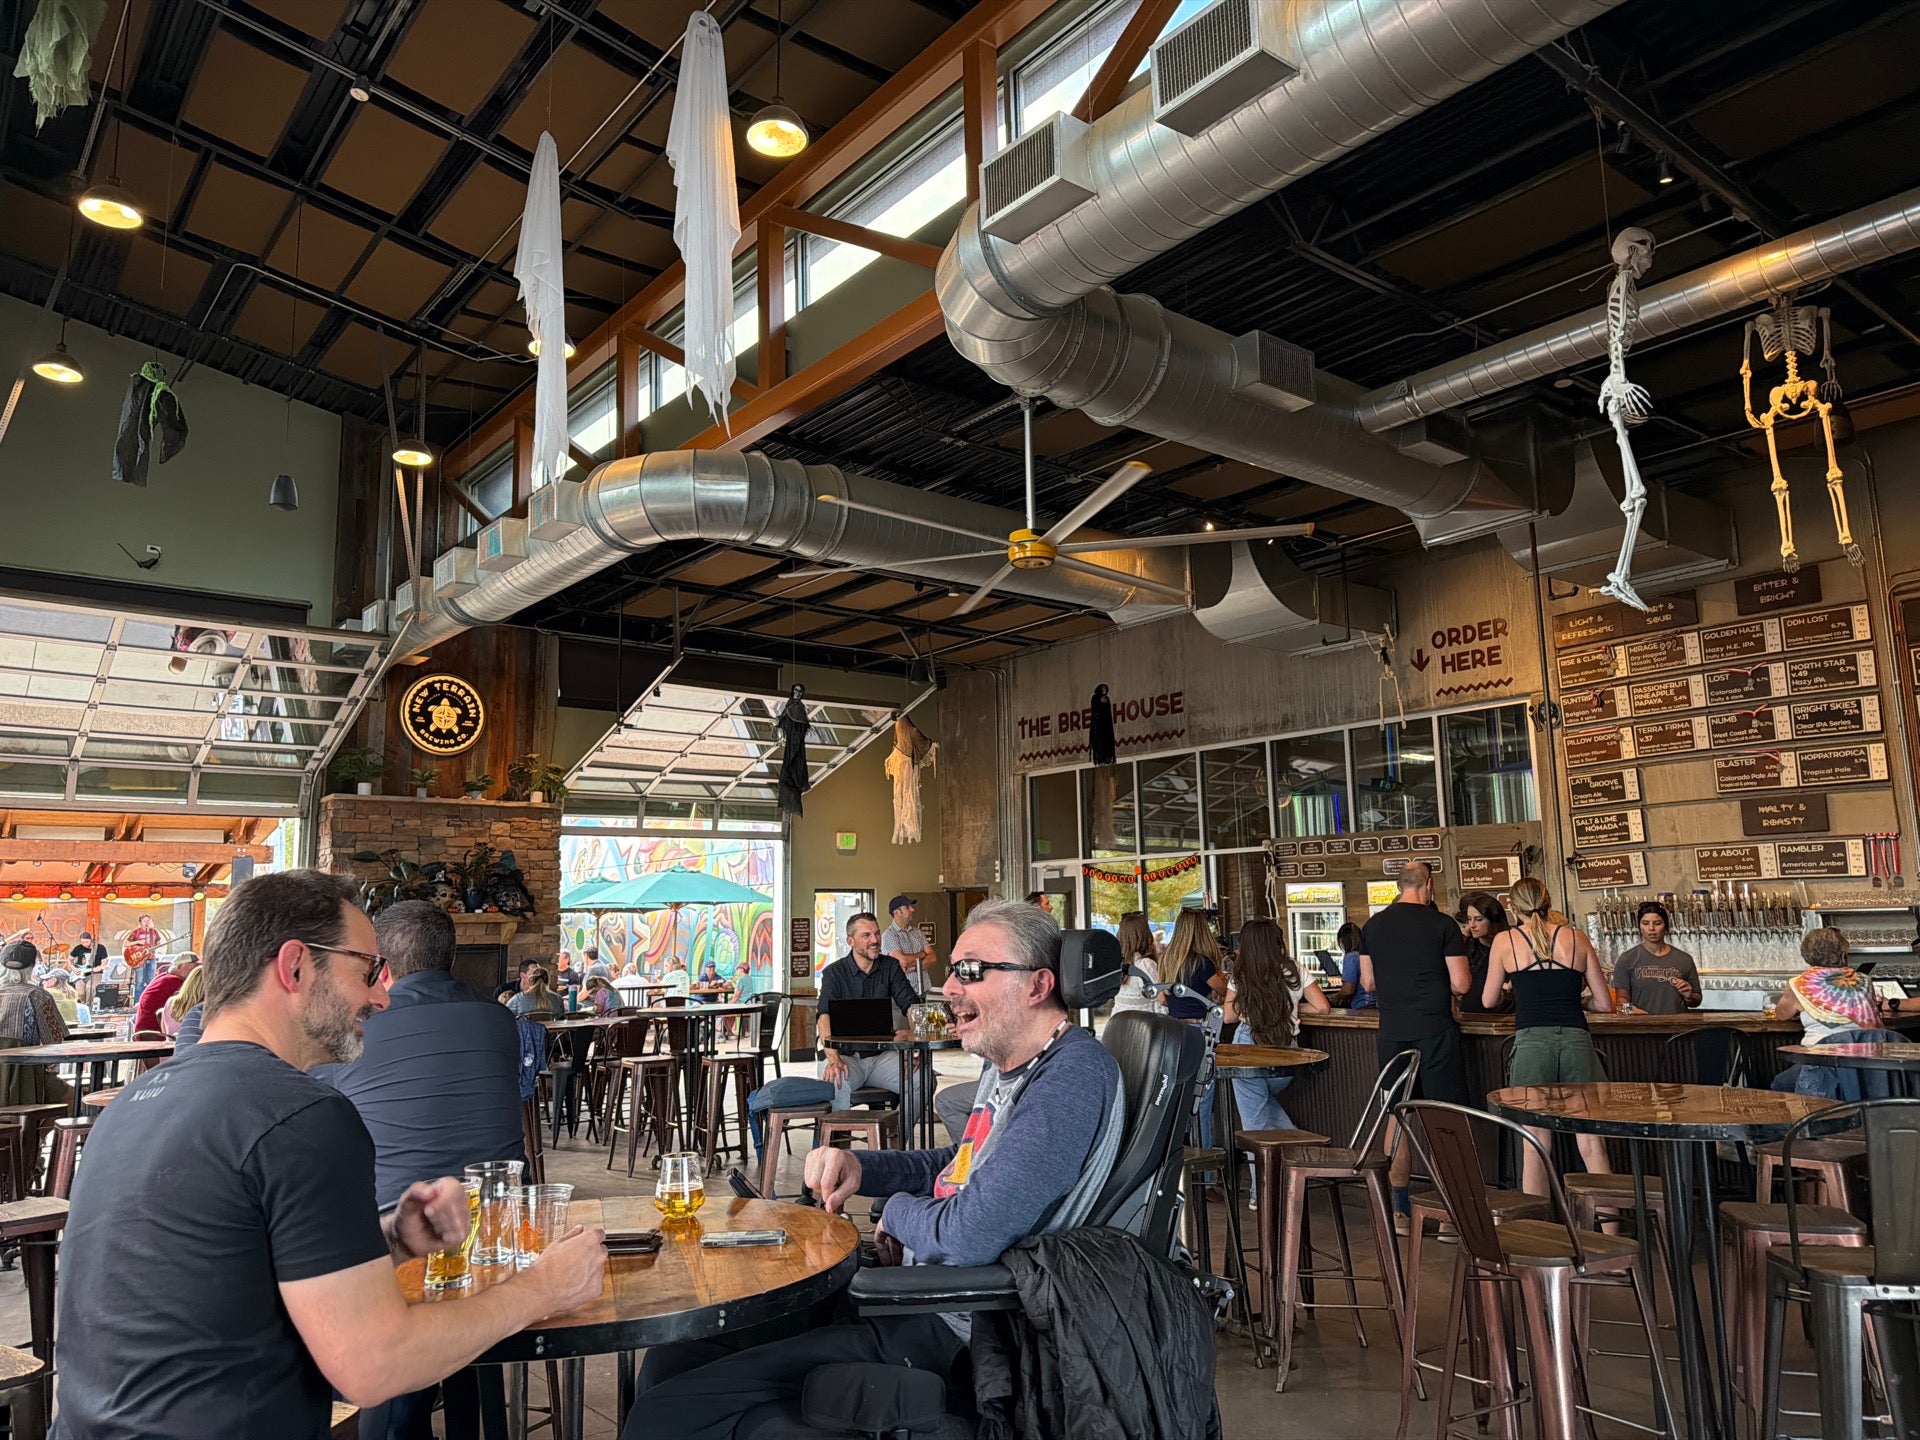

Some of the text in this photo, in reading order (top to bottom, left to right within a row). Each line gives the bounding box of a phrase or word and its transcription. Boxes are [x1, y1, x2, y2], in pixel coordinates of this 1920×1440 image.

[1753, 577, 1800, 592] BITTER &
[1759, 590, 1796, 604] BRIGHT
[1668, 602, 1675, 610] &
[1569, 615, 1594, 628] LIGHT
[1646, 614, 1672, 625] SOUR
[1786, 614, 1829, 627] DDH LOST
[1431, 618, 1509, 650] ORDER
[1561, 624, 1615, 641] REFRESHING
[1704, 625, 1761, 640] GOLDEN HAZE
[1629, 642, 1659, 654] MIRAGE
[1441, 645, 1502, 674] HERE
[1560, 659, 1576, 667] RISE
[1583, 653, 1605, 663] CLIMB
[1630, 650, 1667, 661] Dry-Hopped
[1631, 658, 1652, 667] Mosaic
[1791, 659, 1846, 671] NORTH STAR
[1708, 673, 1731, 683] LOST
[1791, 670, 1808, 678] v.49
[1633, 680, 1687, 694] PASSIONFRUIT
[1792, 678, 1812, 686] Hazy
[1634, 689, 1675, 700] PINEAPPLE
[1710, 688, 1742, 696] Colorado
[412, 687, 429, 713] NEW
[434, 682, 477, 718] TERRAIN
[1562, 694, 1594, 705] SUNTRIP
[1635, 698, 1663, 707] PAPAYA
[1794, 701, 1857, 714] BRIGHT SKIES
[1018, 691, 1184, 740] THE BREHOUSE
[1565, 709, 1590, 718] Belgian
[1711, 716, 1738, 725] NUMB
[1829, 719, 1852, 727] Series
[1638, 721, 1690, 735] TERRA FIRMA
[419, 728, 456, 745] BREWING
[1567, 733, 1616, 746] PILLOW DROPS
[1639, 735, 1653, 743] v.37
[1800, 749, 1867, 761] HOPPATROPICA
[1716, 758, 1757, 769] BLASTER
[1719, 774, 1750, 782] Colorado
[1751, 772, 1766, 780] Pale
[1803, 768, 1833, 777] Tropical
[1571, 777, 1619, 788] LATTE GROOVE
[1758, 803, 1807, 814] MALTY &
[1576, 818, 1593, 826] SALT
[1600, 815, 1618, 823] LIME
[1762, 816, 1805, 827] ROASTY
[1585, 823, 1619, 832] NÓMADA
[1720, 848, 1751, 857] ABOUT
[1780, 844, 1824, 854] RAMBLER
[1462, 860, 1488, 870] SLÜSH
[1577, 858, 1622, 869] LA NÓMADA
[1734, 863, 1754, 871] Stout
